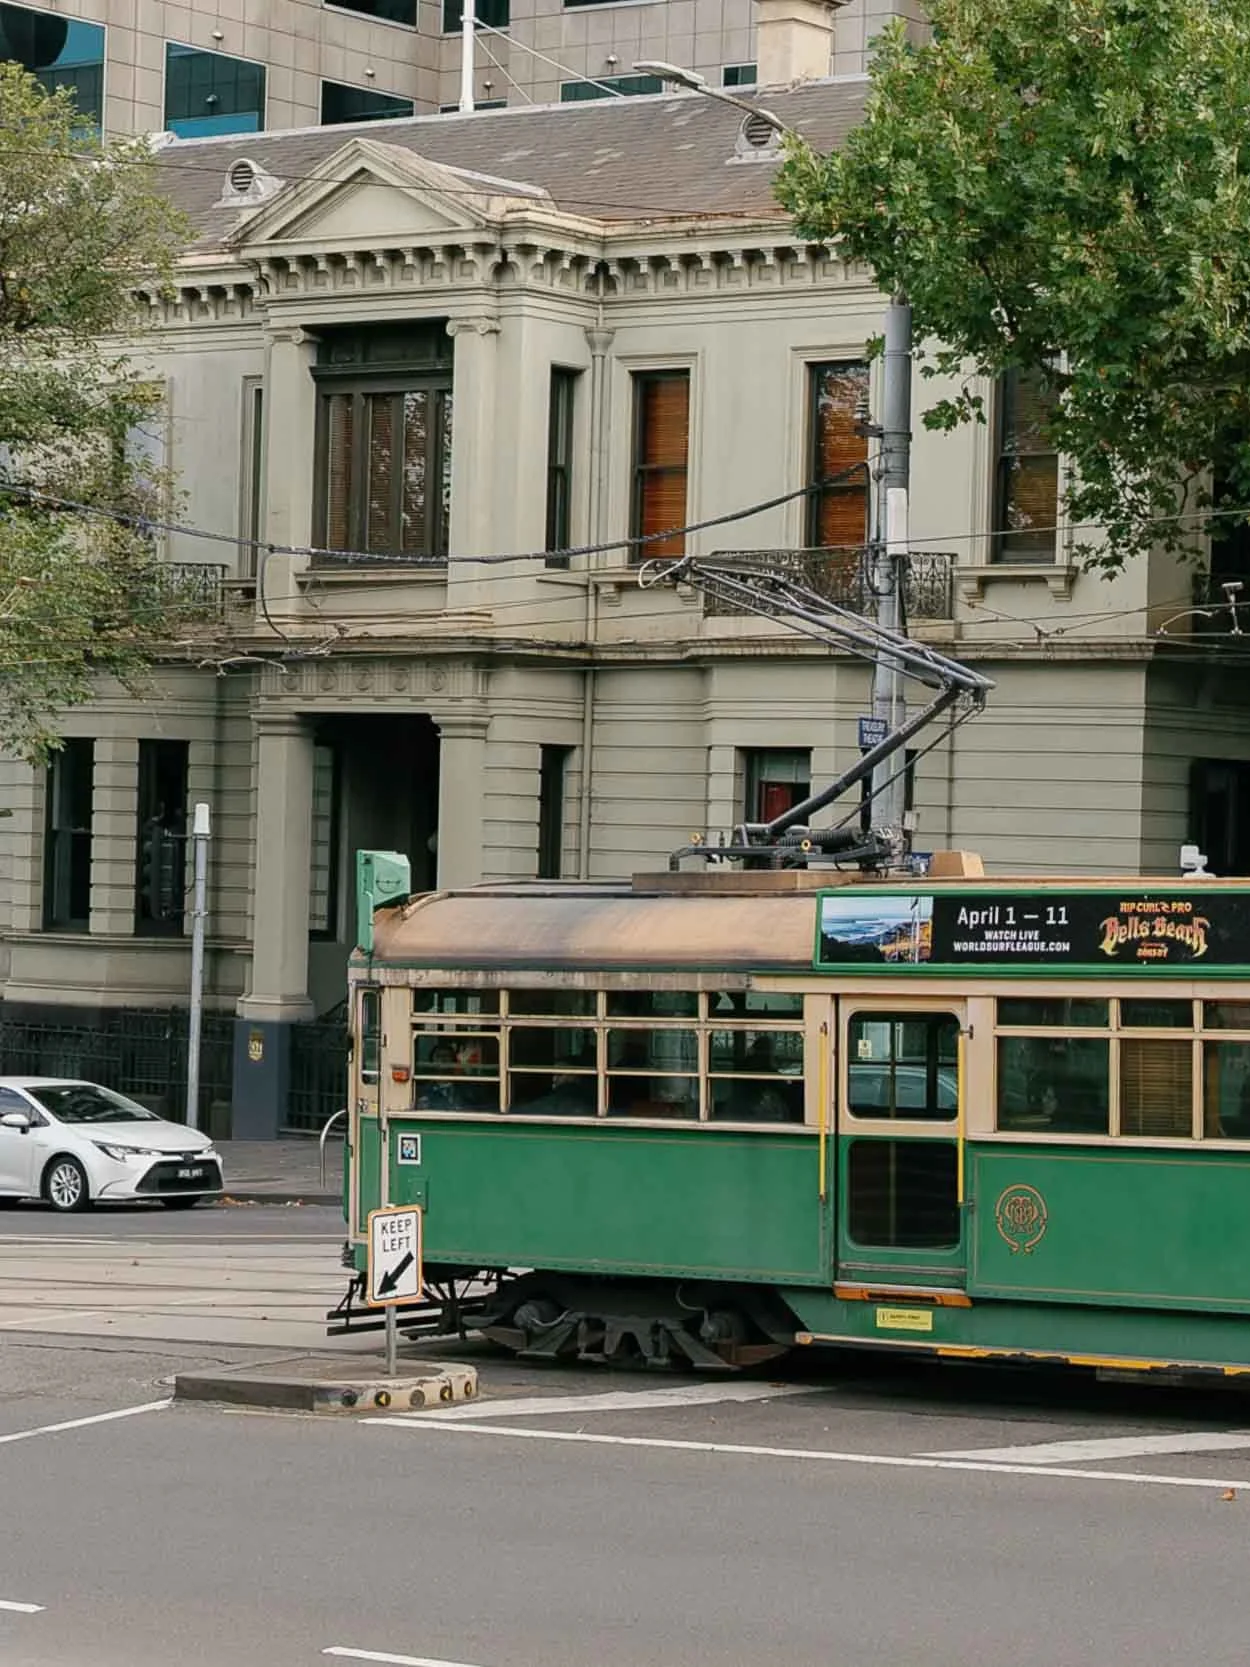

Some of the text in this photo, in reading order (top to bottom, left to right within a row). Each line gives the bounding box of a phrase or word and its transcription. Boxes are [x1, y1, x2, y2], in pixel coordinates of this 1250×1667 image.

[1120, 902, 1192, 913] RIP CURL PRO
[957, 906, 999, 930] April
[1005, 906, 1017, 925] 1
[1045, 906, 1069, 925] 11
[984, 930, 1040, 940] WATCH LIVE
[1099, 915, 1210, 958] Bells Beach
[953, 941, 1071, 952] WORLDSURFLEAGUE.COM
[381, 1219, 412, 1234] KEEP
[383, 1236, 411, 1253] LEFT
